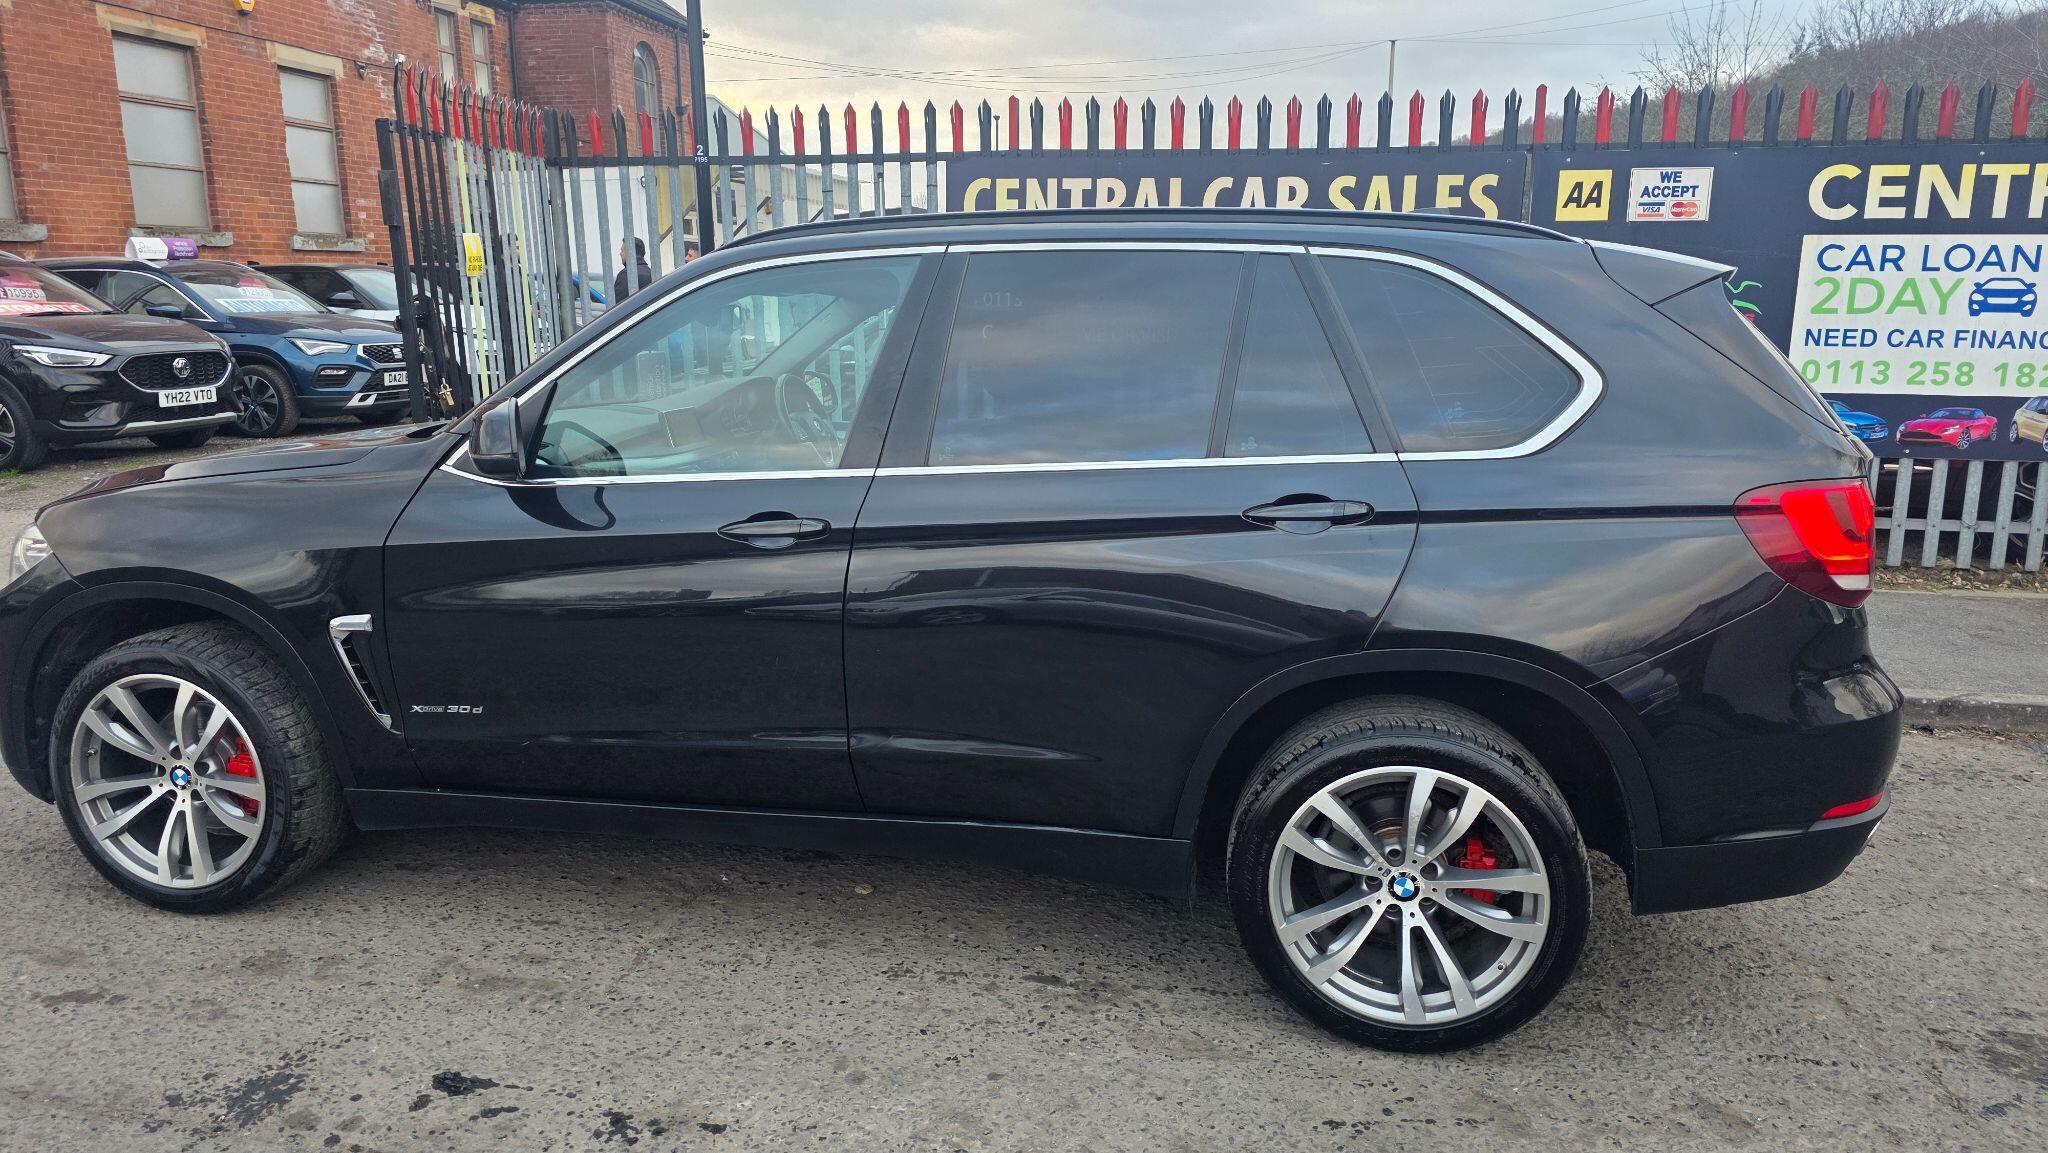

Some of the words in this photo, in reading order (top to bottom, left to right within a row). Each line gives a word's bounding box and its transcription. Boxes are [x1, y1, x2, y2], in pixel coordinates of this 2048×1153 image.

[696, 144, 704, 156] 2
[1660, 170, 1683, 184] WE
[1202, 176, 1309, 208] CAR
[1328, 173, 1500, 220] SALES
[1561, 180, 1604, 209] AA
[1639, 184, 1700, 199] ACCEPT
[1817, 243, 1906, 272] CAR
[1921, 243, 2043, 273] LOAN
[1810, 276, 1965, 316] 2DAY
[1804, 328, 1878, 348] NEED
[1887, 329, 1944, 349] CAR
[1801, 359, 1891, 385] 0113
[1906, 361, 1975, 387] 258
[164, 391, 191, 405] YH22
[193, 389, 213, 402] VTO
